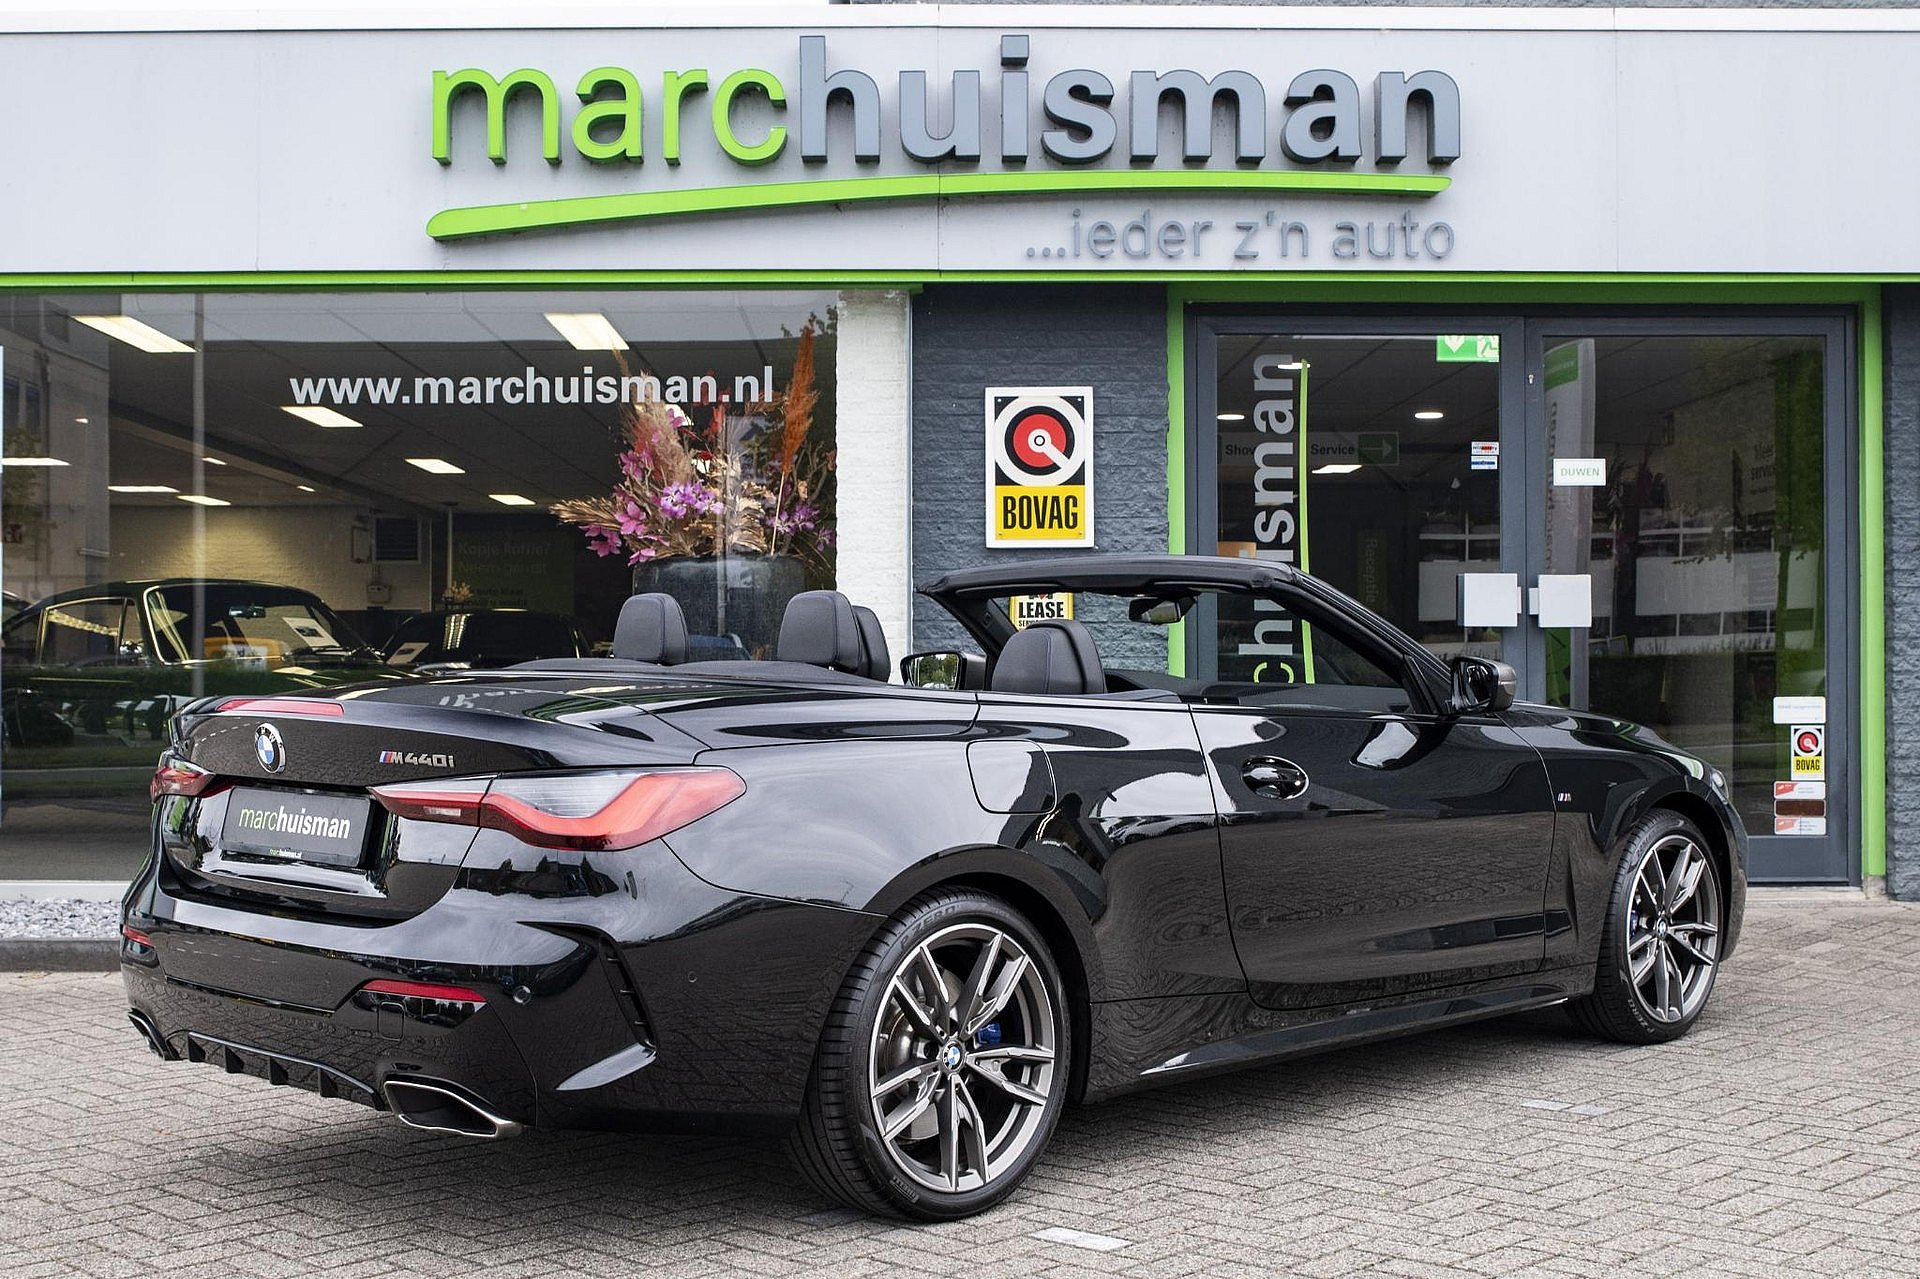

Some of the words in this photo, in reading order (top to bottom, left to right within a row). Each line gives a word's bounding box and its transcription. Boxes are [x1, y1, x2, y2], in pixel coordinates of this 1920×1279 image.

[432, 34, 1462, 166] marchuisman
[1026, 208, 1212, 258] ...ieder
[1234, 210, 1310, 258] z'n
[1332, 209, 1455, 258] auto
[289, 366, 773, 404] www.marchuisman.nl
[1560, 467, 1600, 477] DUWEN
[1003, 495, 1078, 530] BOVAG
[1238, 354, 1294, 685] chisman
[1018, 601, 1065, 619] LEASE
[390, 751, 455, 768] M440i
[1796, 759, 1820, 771] BOVAG
[239, 805, 351, 839] marchuisman
